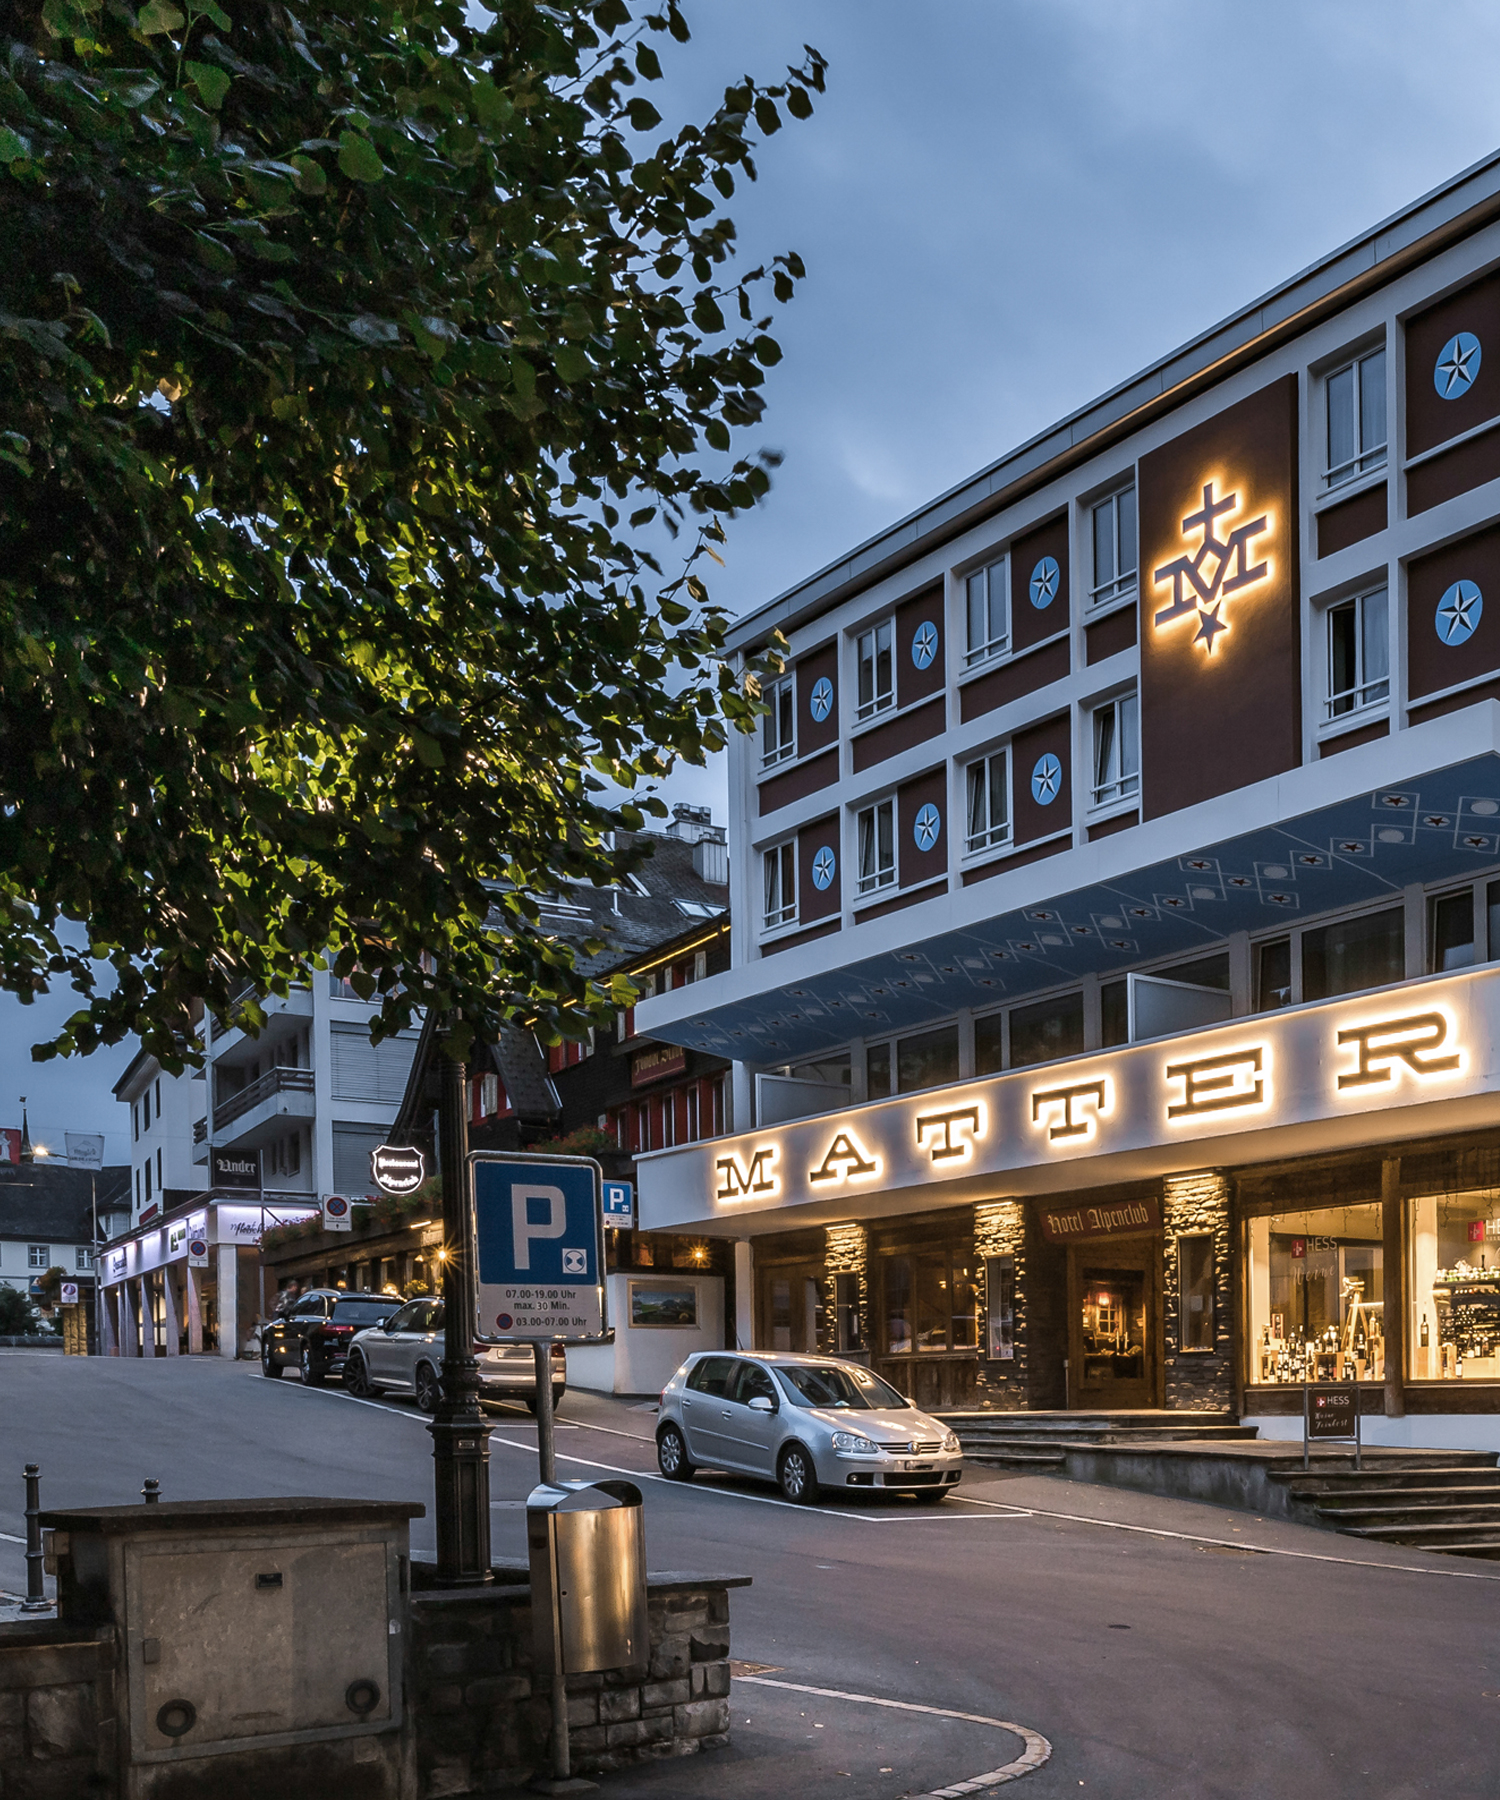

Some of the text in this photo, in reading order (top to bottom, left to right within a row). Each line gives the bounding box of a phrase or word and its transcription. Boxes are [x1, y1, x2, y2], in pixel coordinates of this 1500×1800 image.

[716, 1011, 1461, 1199] MATTER
[609, 1187, 625, 1211] P
[511, 1183, 567, 1270] P
[1047, 1202, 1150, 1235] Hotel Alpenclub
[1305, 1235, 1338, 1253] HESS
[505, 1289, 577, 1299] 07.00-19.00 Uhr
[513, 1301, 570, 1311] max. 30 Min.
[516, 1316, 587, 1327] 03.00-07.00 Uhr
[1327, 1395, 1350, 1406] HESS
